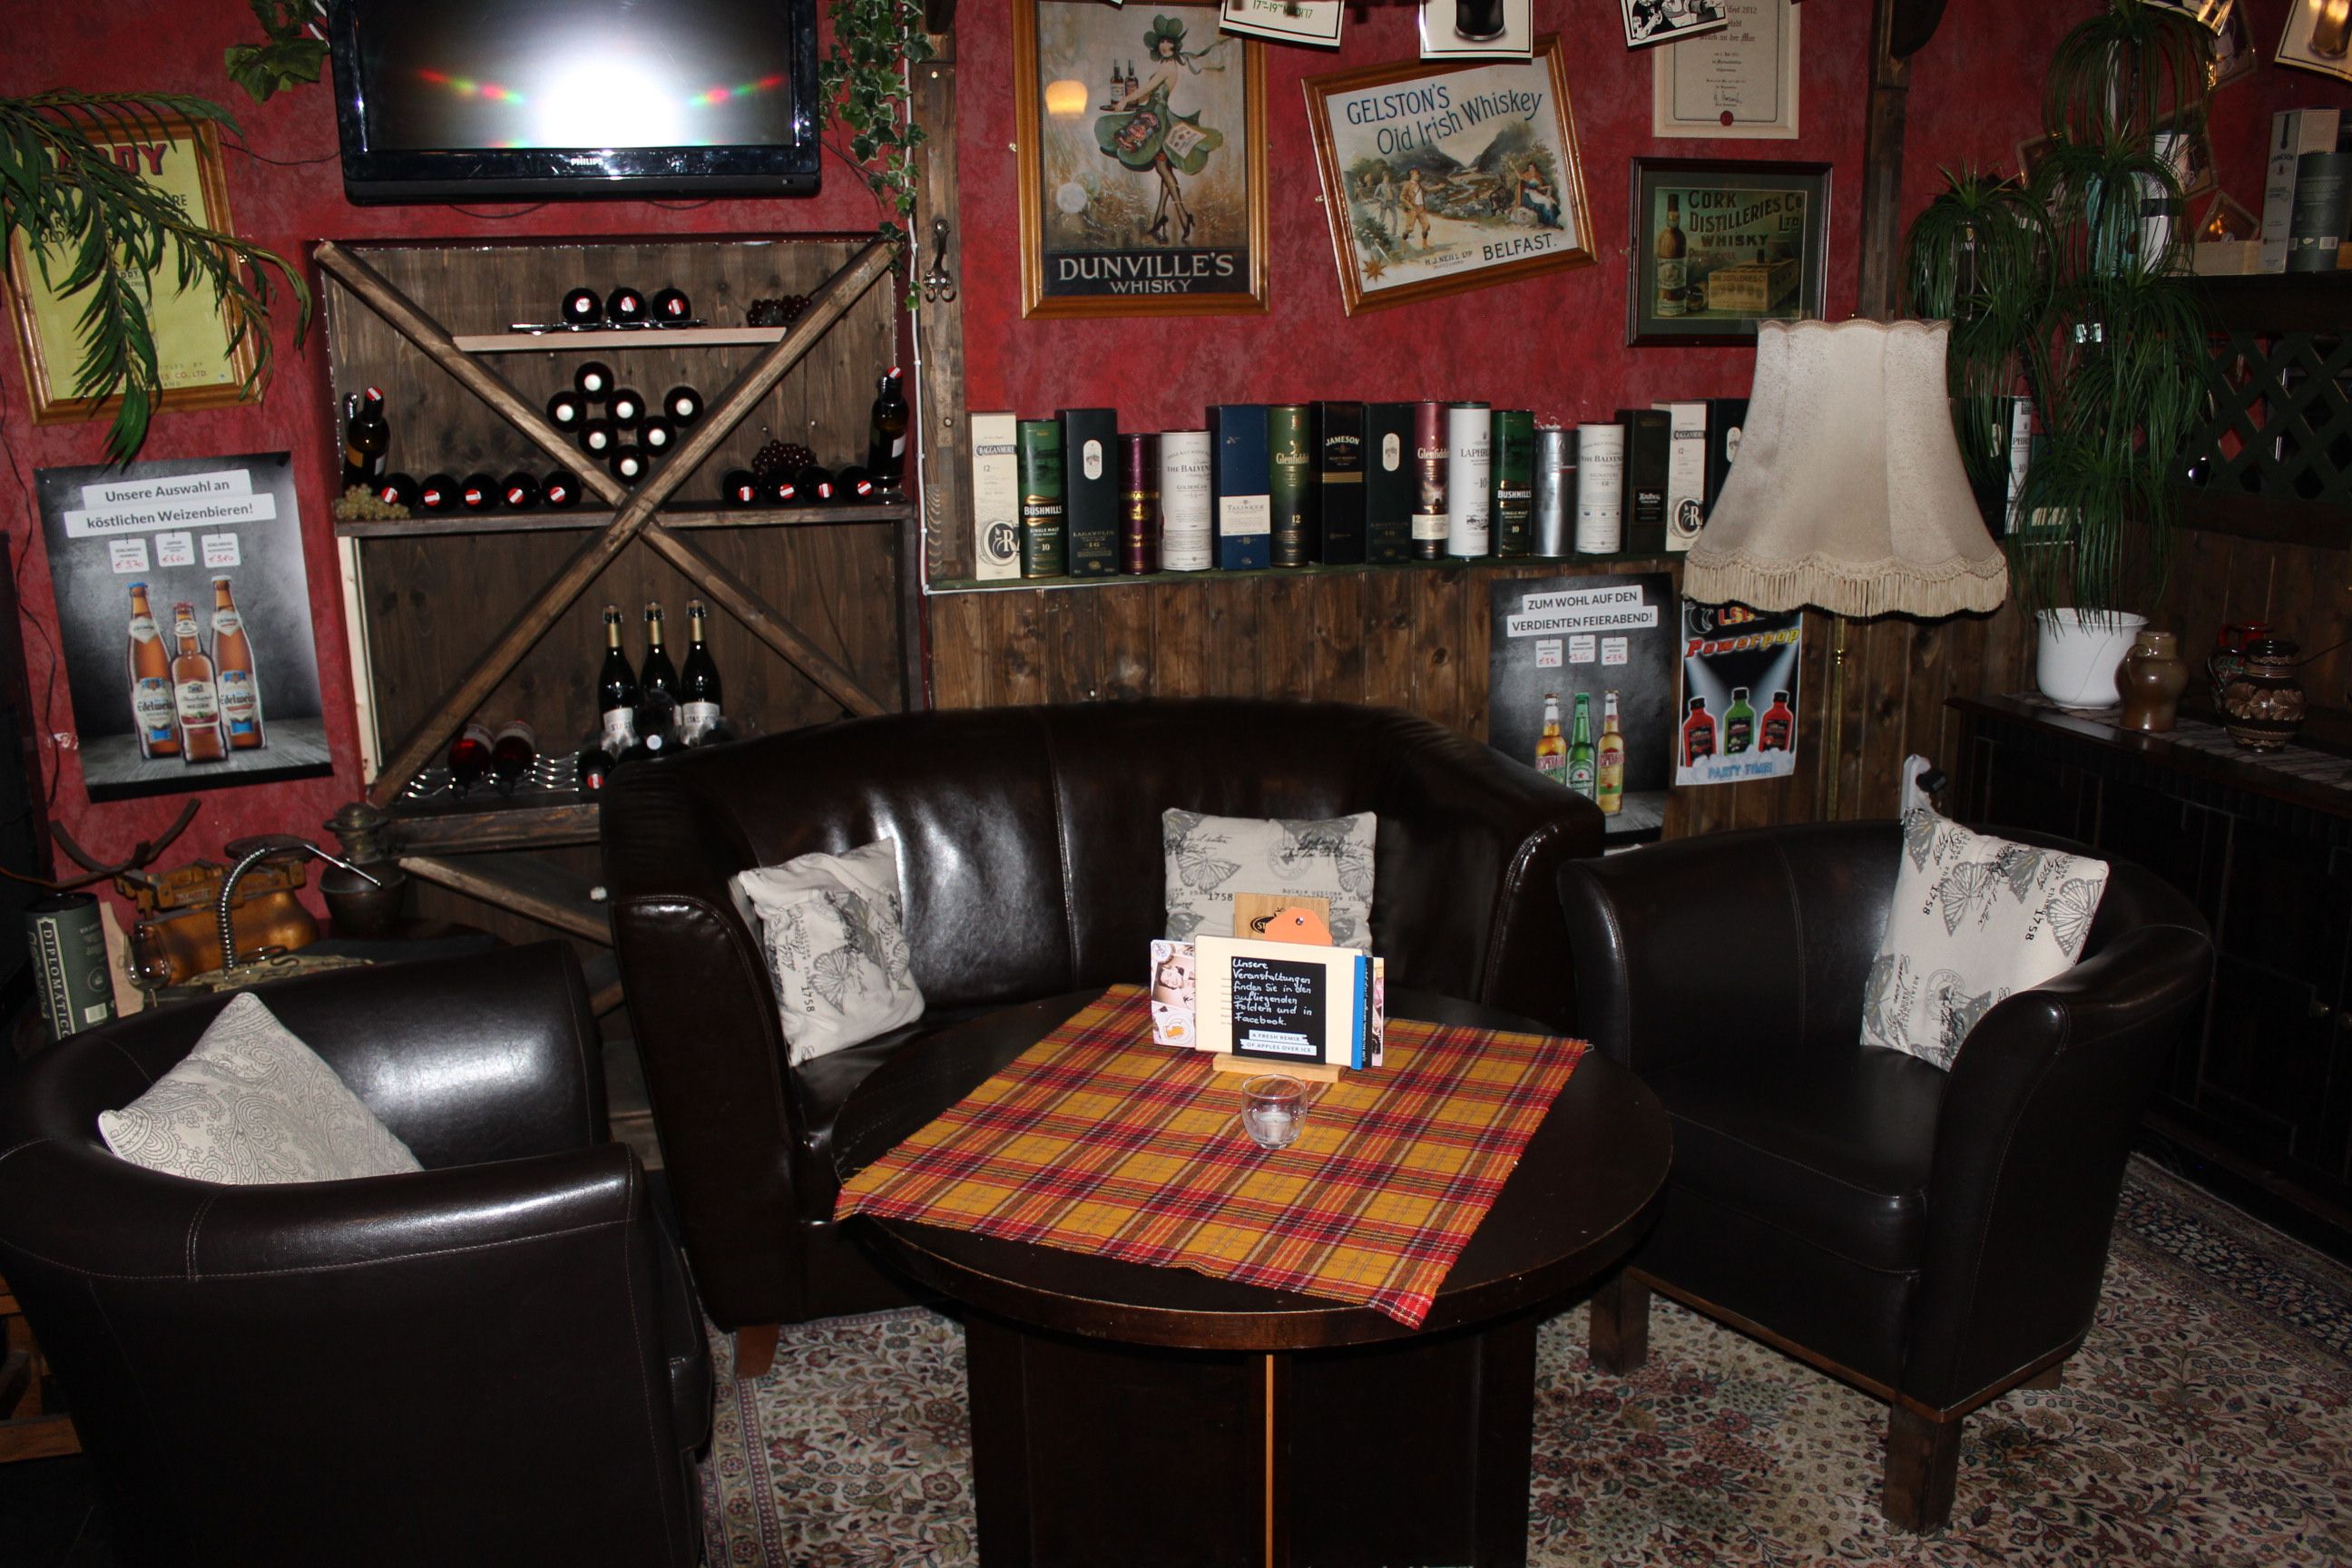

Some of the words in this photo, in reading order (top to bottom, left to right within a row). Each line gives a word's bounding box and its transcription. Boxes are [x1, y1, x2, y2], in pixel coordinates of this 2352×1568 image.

[1347, 83, 1451, 125] GELSTON'S
[1416, 110, 1463, 146] Irish
[1460, 89, 1543, 126] Whiskey
[571, 158, 603, 166] PHILIPS
[1688, 190, 1737, 209] CORK
[1689, 197, 1782, 233] DISTILLERIES
[1483, 232, 1557, 261] BELFAST.
[1700, 233, 1769, 248] WHISKY
[1059, 251, 1234, 281] DUNVILLE'S
[1108, 279, 1192, 294] WHISKY
[1326, 436, 1360, 446] JAMESON
[984, 465, 991, 473] 12
[105, 488, 152, 502] Unsere
[155, 480, 211, 497] Auswahl
[214, 480, 230, 491] an
[1497, 490, 1532, 499] BUSHMILLS
[87, 513, 155, 529] köstlichen
[157, 504, 253, 523] Weizenbieren!
[1024, 505, 1063, 516] BUSHMILLS
[1291, 514, 1301, 524] 12
[1042, 543, 1051, 552] 10
[1528, 600, 1553, 611] ZUM
[1555, 595, 1590, 608] WOHL
[1592, 593, 1612, 604] AUF
[1615, 592, 1637, 603] DEN
[1513, 617, 1581, 632] VERDIENTEN
[1583, 612, 1652, 626] FEIERABEND!
[1684, 627, 1801, 658] Powerpop
[1708, 764, 1741, 779] PARTY
[1208, 893, 1233, 901] 1758
[2024, 907, 2043, 941] 1758
[1233, 958, 1269, 969] Unsere
[1233, 968, 1310, 987] Veranstaltungen
[1233, 980, 1262, 992] finden
[1265, 983, 1278, 992] Sie
[1283, 985, 1293, 993] in
[1295, 984, 1311, 994] den
[800, 985, 816, 1013] 1758
[1233, 991, 1298, 1007] aufliegenden
[1233, 1000, 1272, 1013] Foldern
[1277, 1005, 1298, 1014] und
[1303, 1005, 1312, 1015] in
[1234, 1012, 1287, 1025] Facebook.
